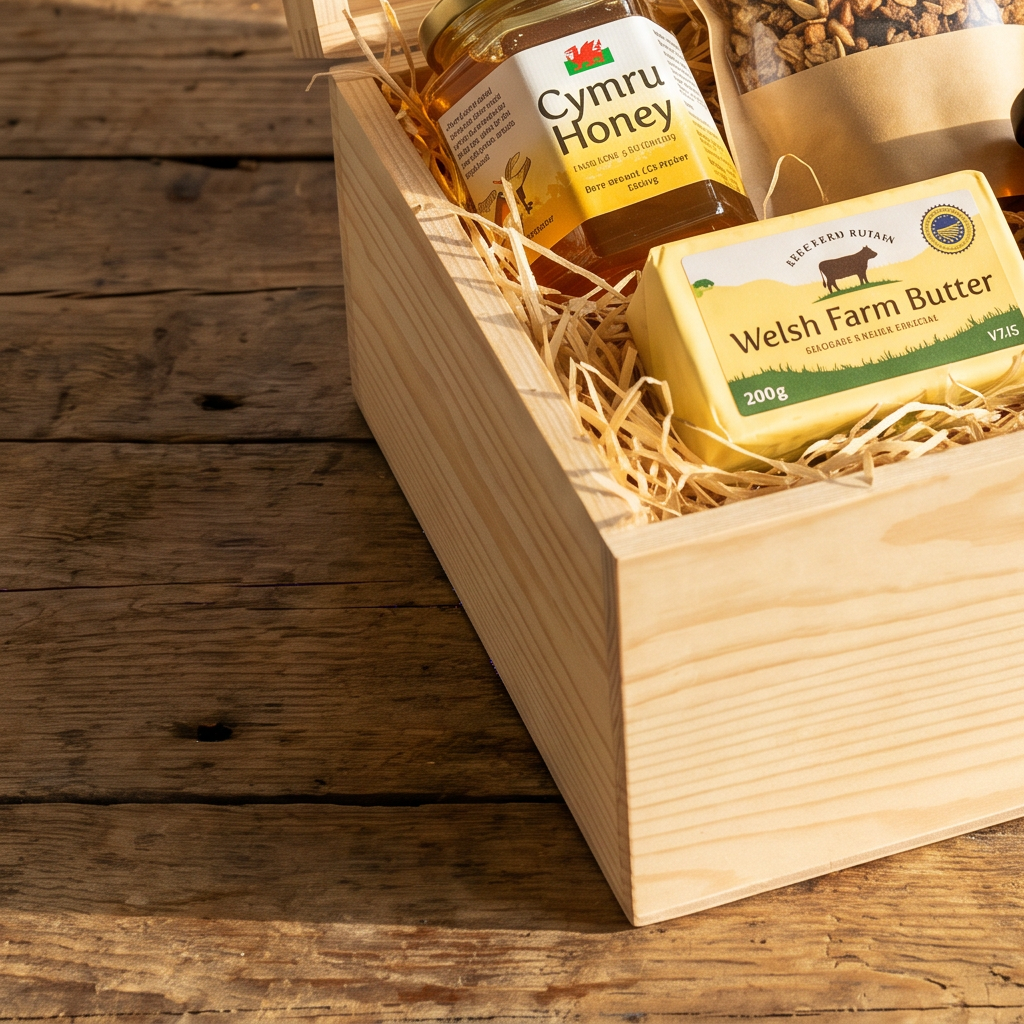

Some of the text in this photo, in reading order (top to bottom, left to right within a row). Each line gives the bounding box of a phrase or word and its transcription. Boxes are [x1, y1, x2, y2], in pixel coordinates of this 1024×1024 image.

[537, 64, 665, 121] Cymru
[552, 99, 672, 155] Honey
[729, 313, 821, 355] Welsh
[825, 297, 901, 337] Farm
[905, 273, 993, 311] Butter
[743, 386, 789, 406] 200g
